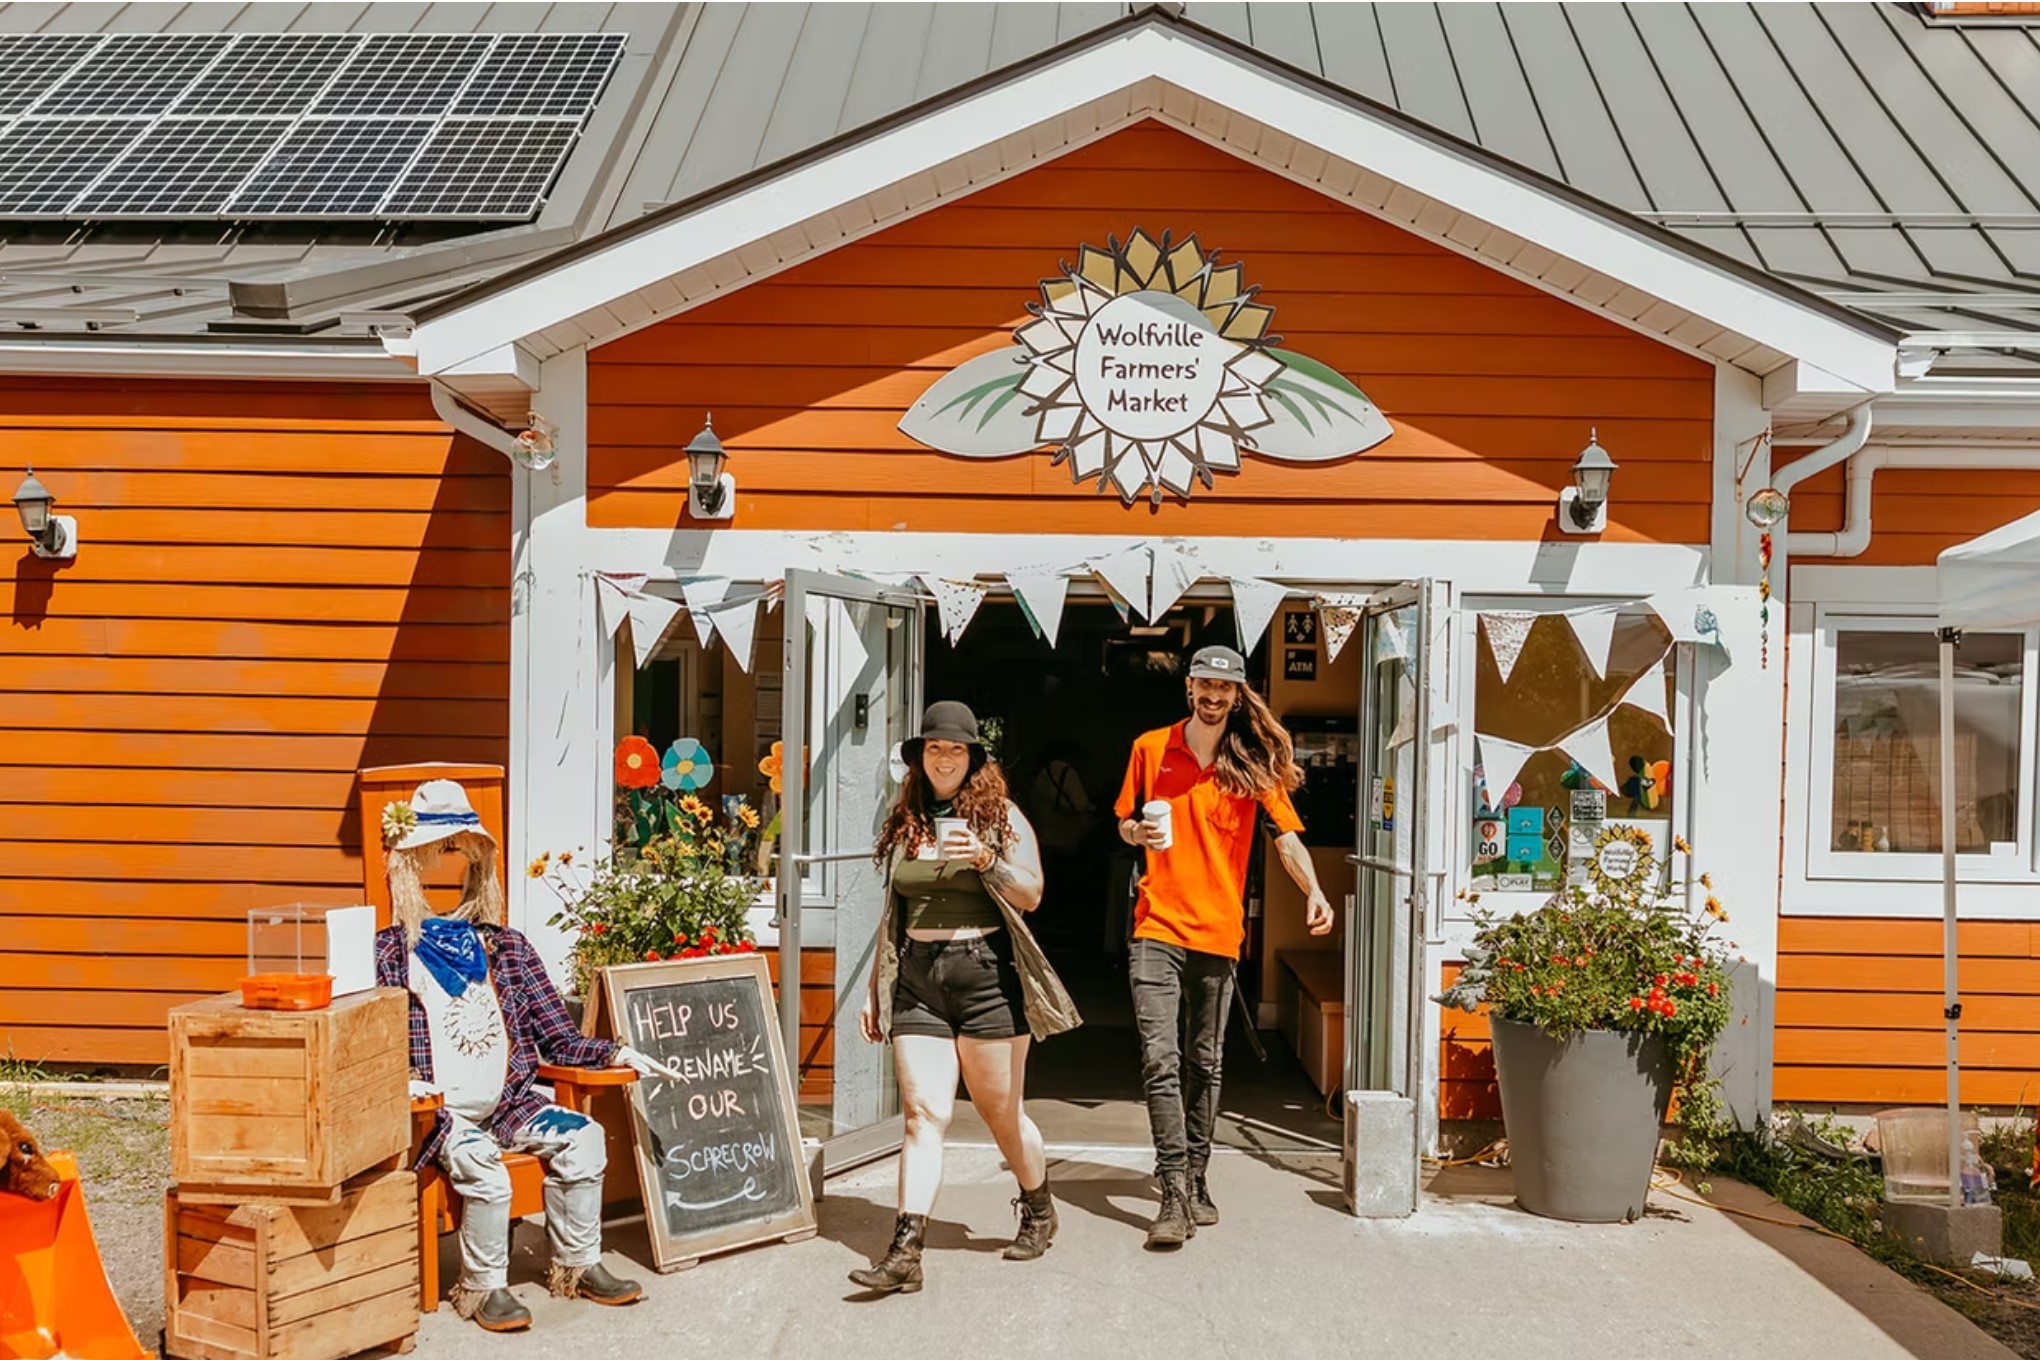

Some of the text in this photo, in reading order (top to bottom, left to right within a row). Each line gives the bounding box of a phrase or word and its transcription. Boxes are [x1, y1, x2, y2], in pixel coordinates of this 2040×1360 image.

[1096, 323, 1203, 347] Wolfville
[1101, 356, 1200, 379] Farmers'
[1107, 389, 1188, 412] Market
[1288, 661, 1313, 672] ATM
[1479, 842, 1498, 855] GO
[633, 1001, 740, 1040] HELP US
[666, 1047, 753, 1088] RENAME
[687, 1090, 746, 1120] OUR
[666, 1132, 775, 1179] SCARECROW
